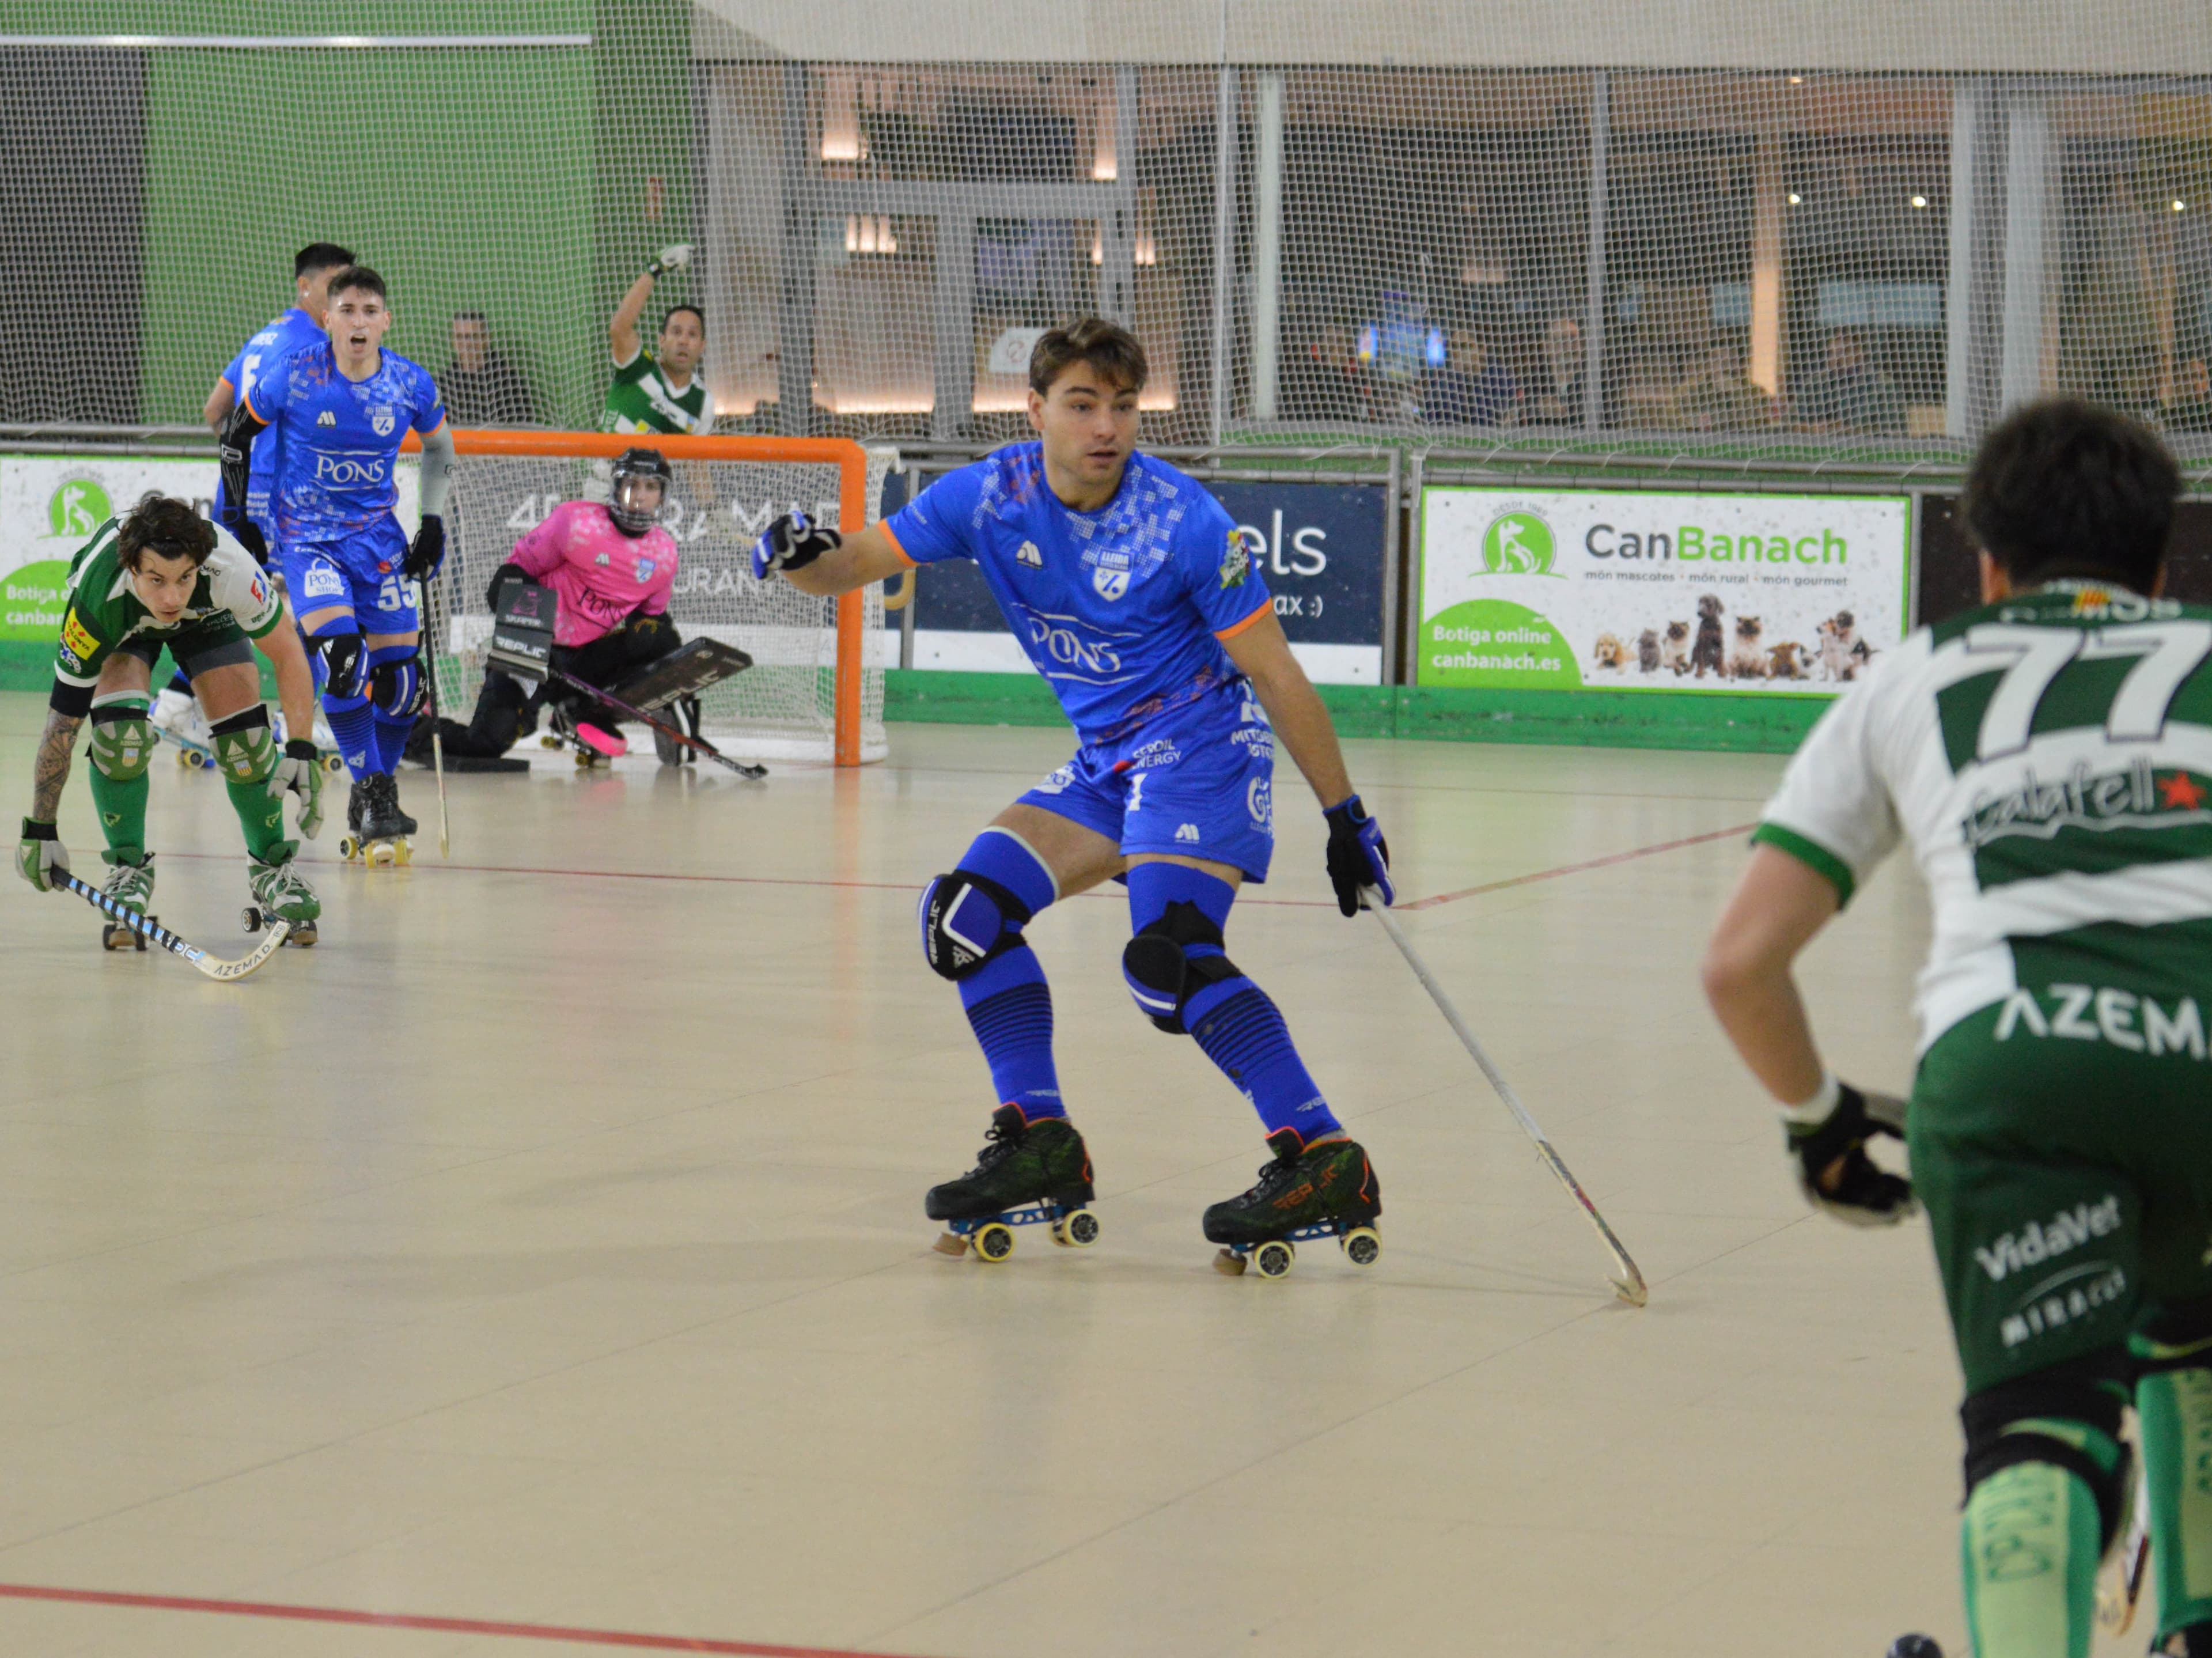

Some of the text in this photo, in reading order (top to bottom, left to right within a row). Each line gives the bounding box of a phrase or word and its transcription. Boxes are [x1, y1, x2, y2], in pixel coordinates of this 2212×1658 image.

[315, 455, 384, 483] PONS
[1585, 523, 1848, 565] CanBanach
[7, 583, 56, 604] Botiga
[377, 575, 416, 612] 55
[1586, 570, 1848, 588] món mascotes món rural món gourmet
[495, 636, 547, 658] REPLIC
[1028, 617, 1121, 673] PONS
[1433, 626, 1551, 645] Botiga online
[1433, 651, 1562, 671] canbanach.es
[1964, 618, 2212, 765] 77
[927, 899, 941, 966] REPLIC
[214, 944, 273, 977] AZEMAD
[1994, 983, 2212, 1061] AZEM
[1974, 1193, 2121, 1282] VidaVet
